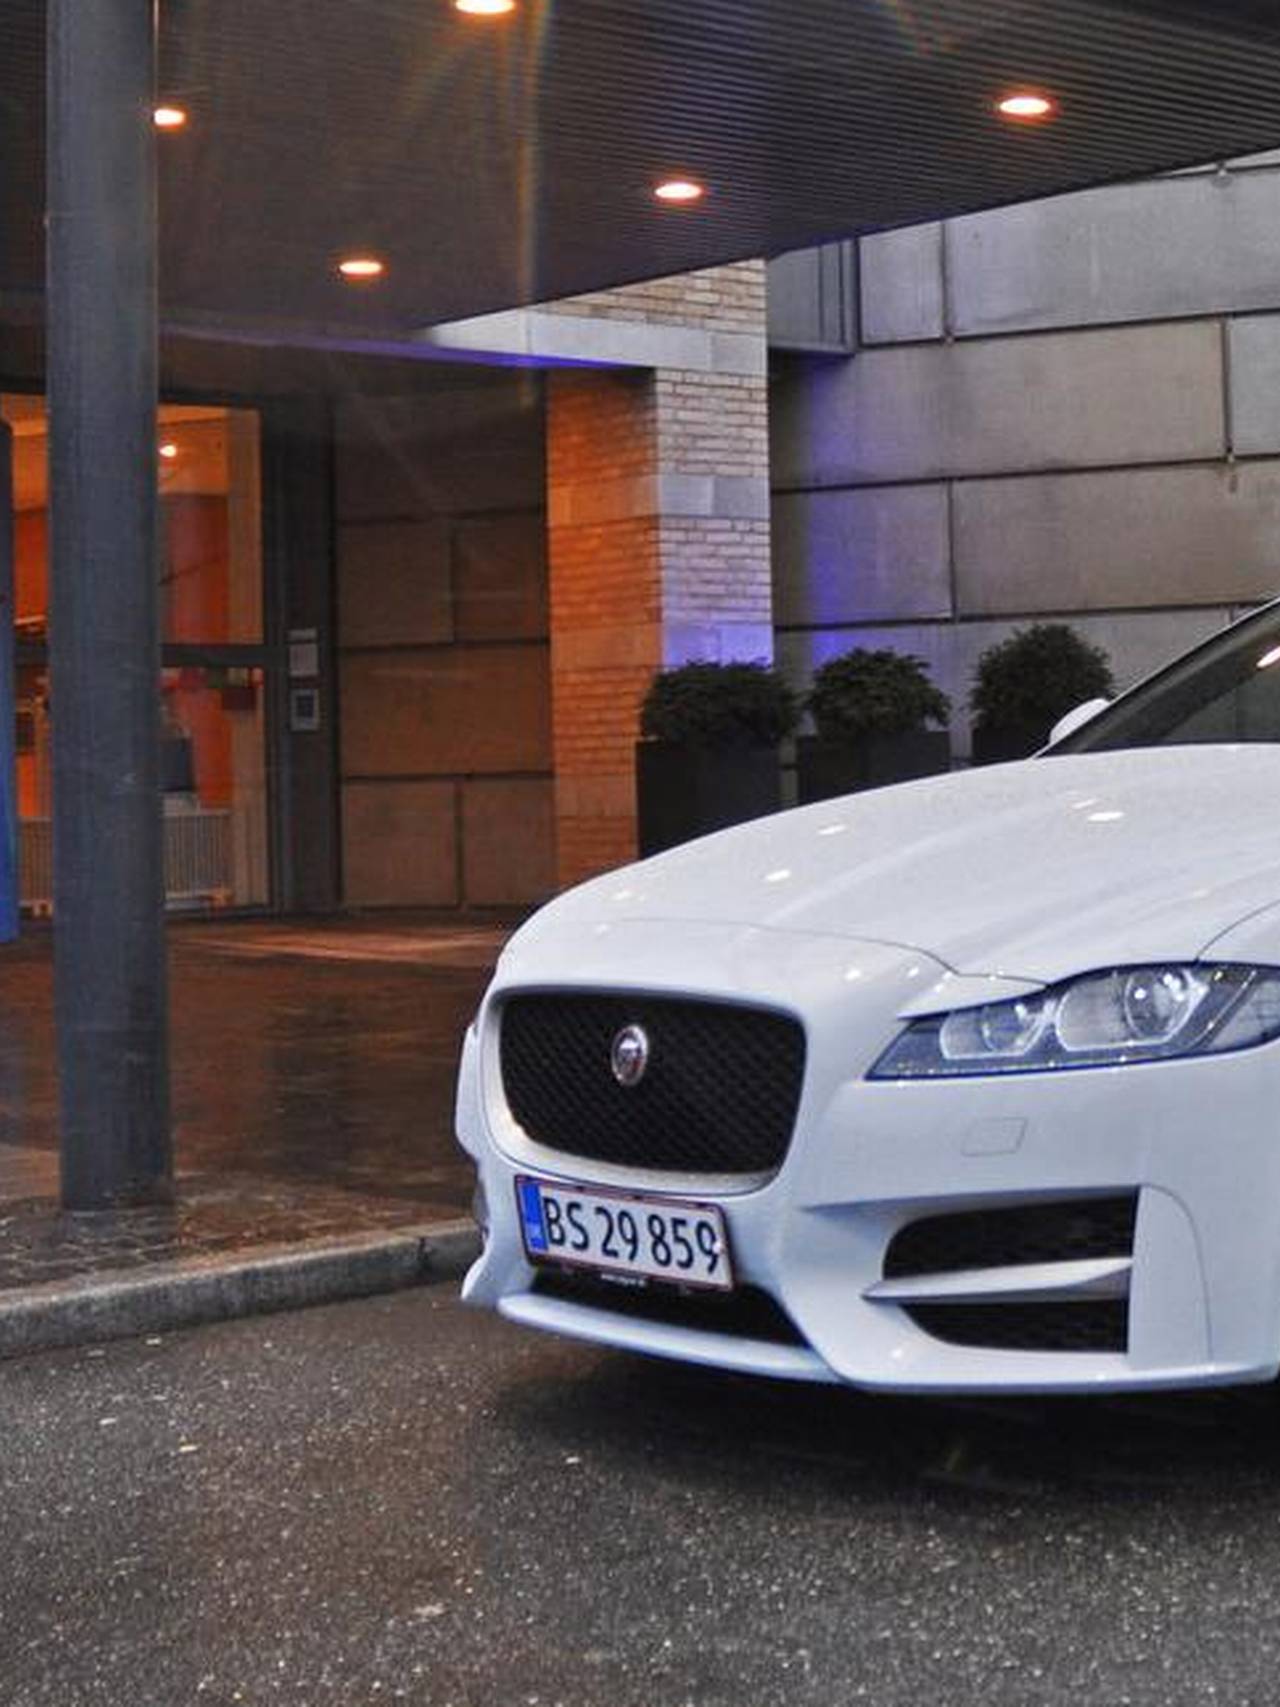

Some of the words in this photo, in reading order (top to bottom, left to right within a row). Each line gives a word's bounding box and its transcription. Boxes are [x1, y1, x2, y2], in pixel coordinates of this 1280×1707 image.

[543, 1197, 589, 1250] BS
[595, 1206, 639, 1261] 29
[648, 1213, 720, 1274] 859
